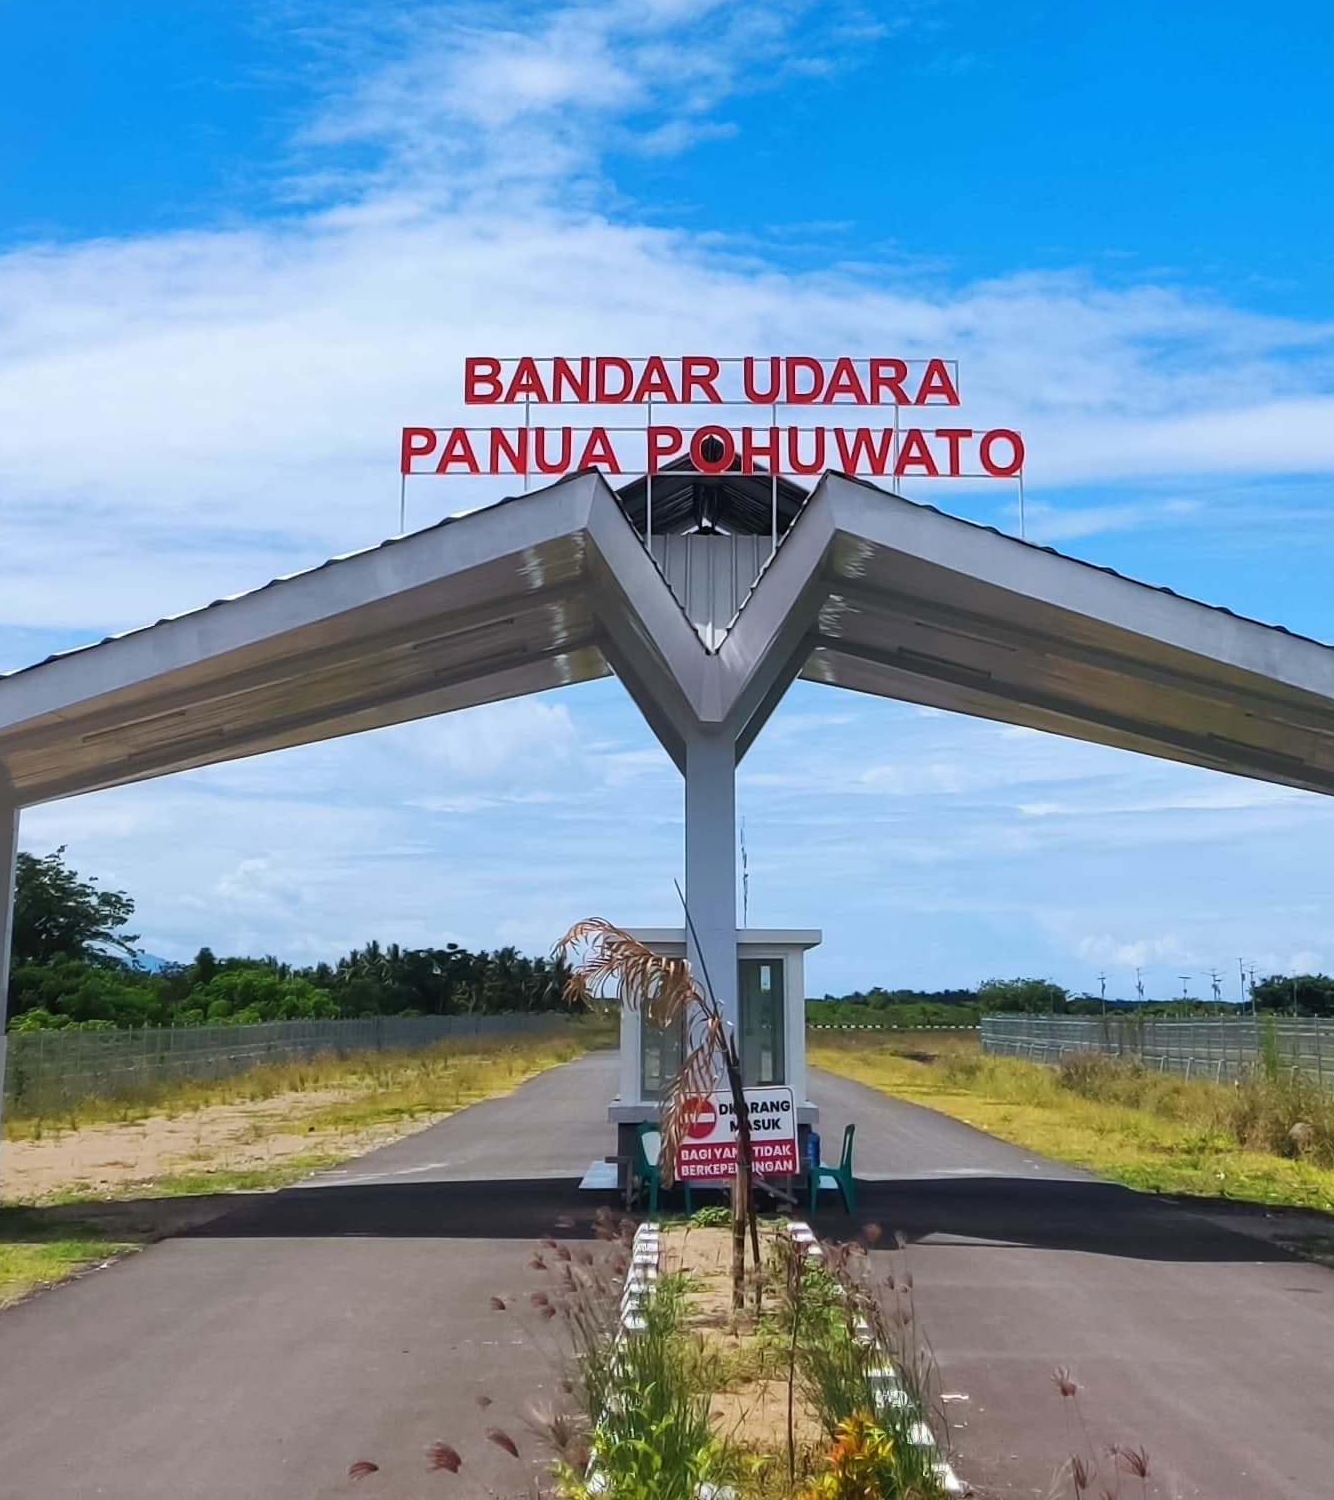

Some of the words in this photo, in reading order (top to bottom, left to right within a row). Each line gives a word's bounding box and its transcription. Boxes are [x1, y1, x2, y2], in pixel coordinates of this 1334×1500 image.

[465, 356, 721, 405] BANDAR
[744, 357, 960, 406] UDARA
[401, 426, 621, 475] PANUA
[647, 425, 1026, 478] POHUWATO
[719, 1100, 791, 1116] DIRANG
[681, 1149, 712, 1161] BAGI
[714, 1146, 741, 1160] YAN
[752, 1145, 792, 1158] TIDAK
[681, 1160, 793, 1177] BERKEPEINGAN
